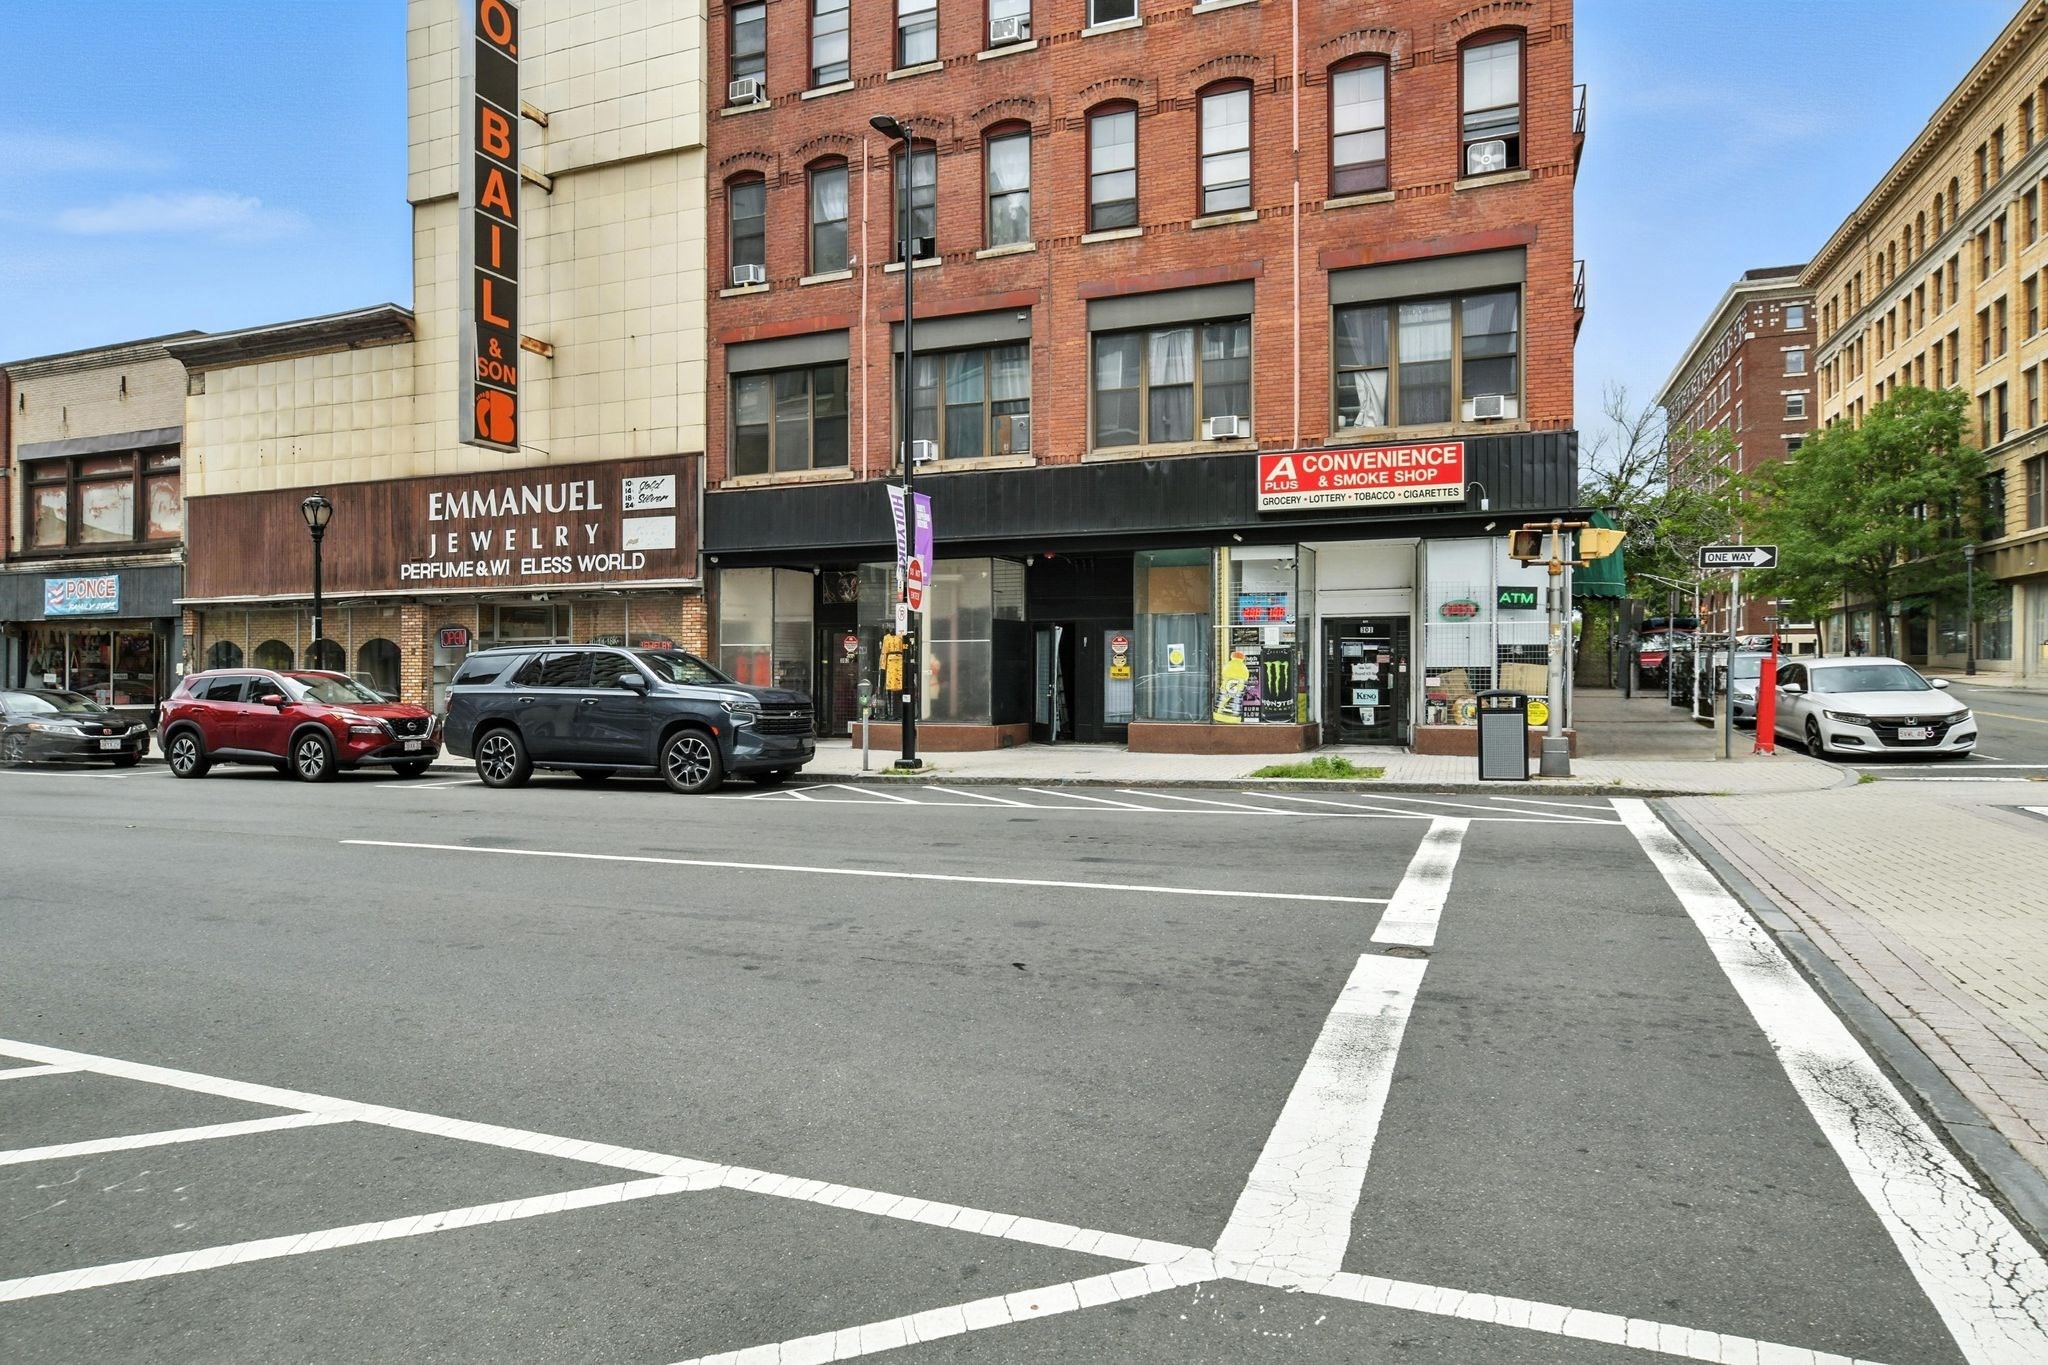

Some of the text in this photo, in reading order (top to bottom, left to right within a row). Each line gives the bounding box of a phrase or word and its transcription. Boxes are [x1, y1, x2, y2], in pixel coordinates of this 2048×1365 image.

[481, 106, 513, 328] BAIL
[489, 338, 503, 359] &
[478, 356, 516, 386] SON
[1265, 457, 1297, 481] A
[1302, 446, 1457, 473] CONVENIENCE
[1264, 480, 1298, 491] PLUS
[1318, 468, 1438, 487] & SMOKE SHOP
[429, 480, 602, 521] EMMANUEL
[1262, 487, 1459, 506] GROCERY LOTTERY TOBACCO CIGARETTES
[429, 523, 599, 559] JEWELRY
[401, 561, 473, 580] PERFUME
[476, 560, 488, 576] &
[577, 552, 646, 572] WORLD
[1708, 553, 1752, 561] ONE WAY
[66, 577, 116, 599] PONCE
[1499, 592, 1534, 604] ATM
[443, 631, 466, 646] OPEN
[1262, 699, 1294, 708] MONSTER
